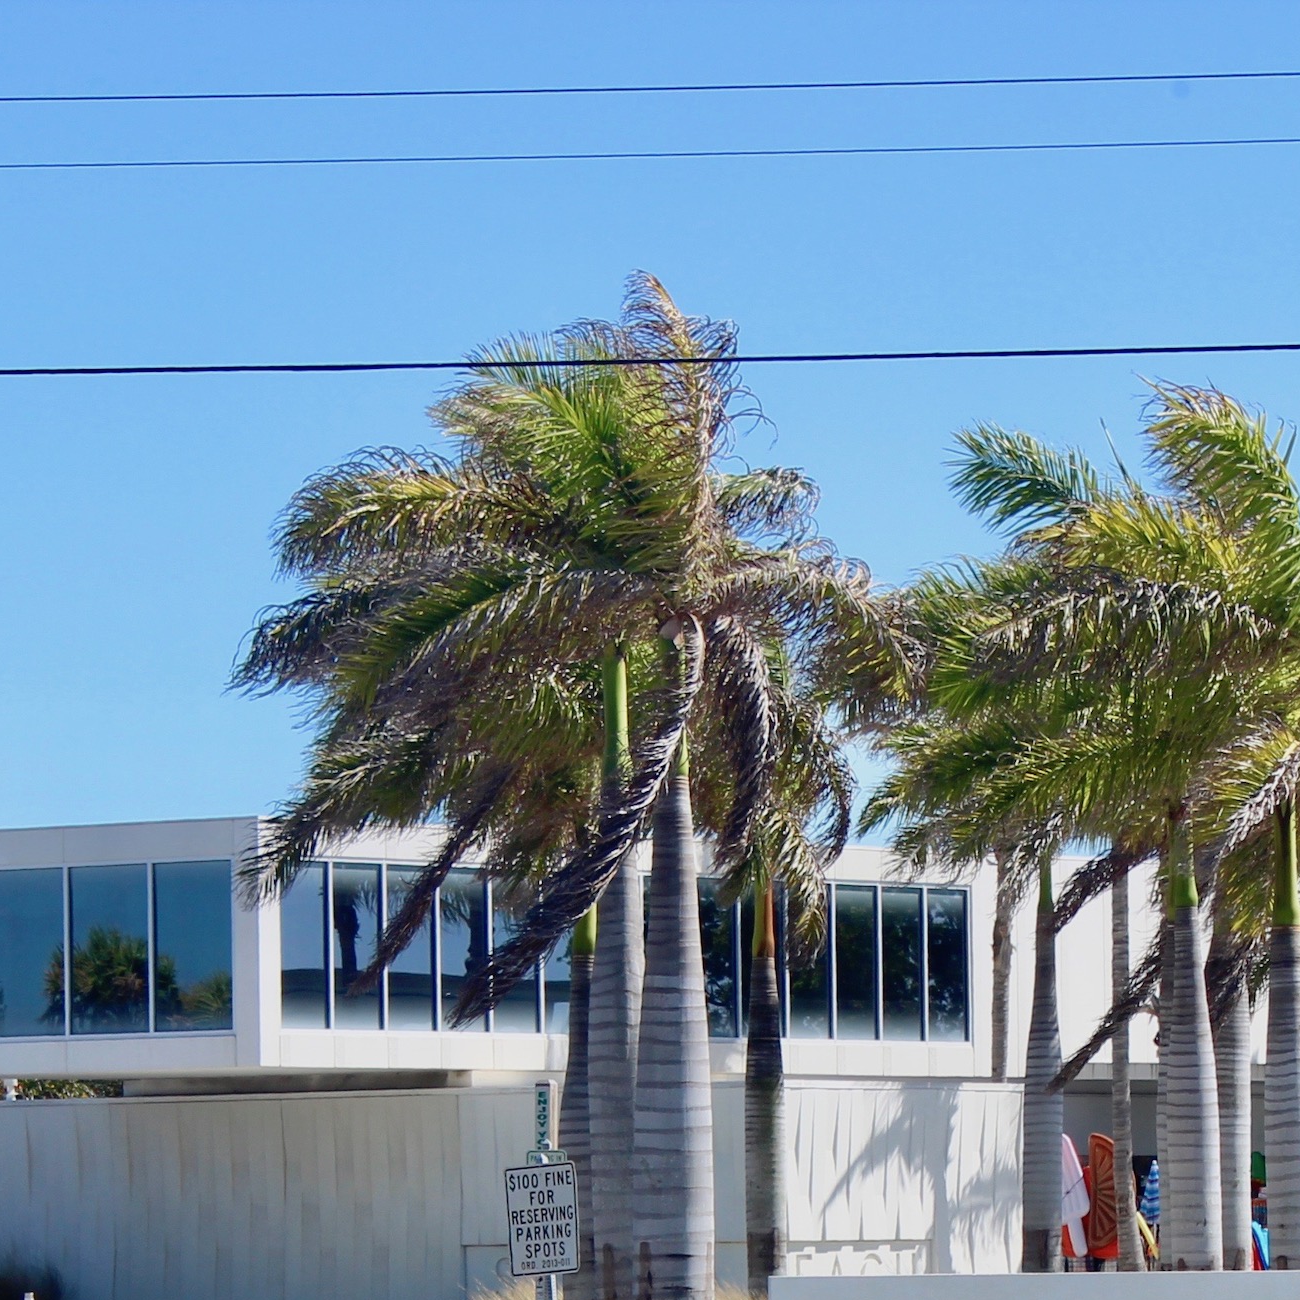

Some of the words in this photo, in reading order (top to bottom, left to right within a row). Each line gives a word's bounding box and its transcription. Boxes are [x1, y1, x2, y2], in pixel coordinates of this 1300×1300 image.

[537, 1091, 548, 1128] ENJOY
[509, 1173, 539, 1192] $100
[545, 1170, 572, 1187] FINE
[529, 1189, 555, 1206] FOR
[511, 1205, 573, 1225] RESERVING
[516, 1223, 572, 1242] PARKING
[525, 1241, 565, 1259] SPOTS
